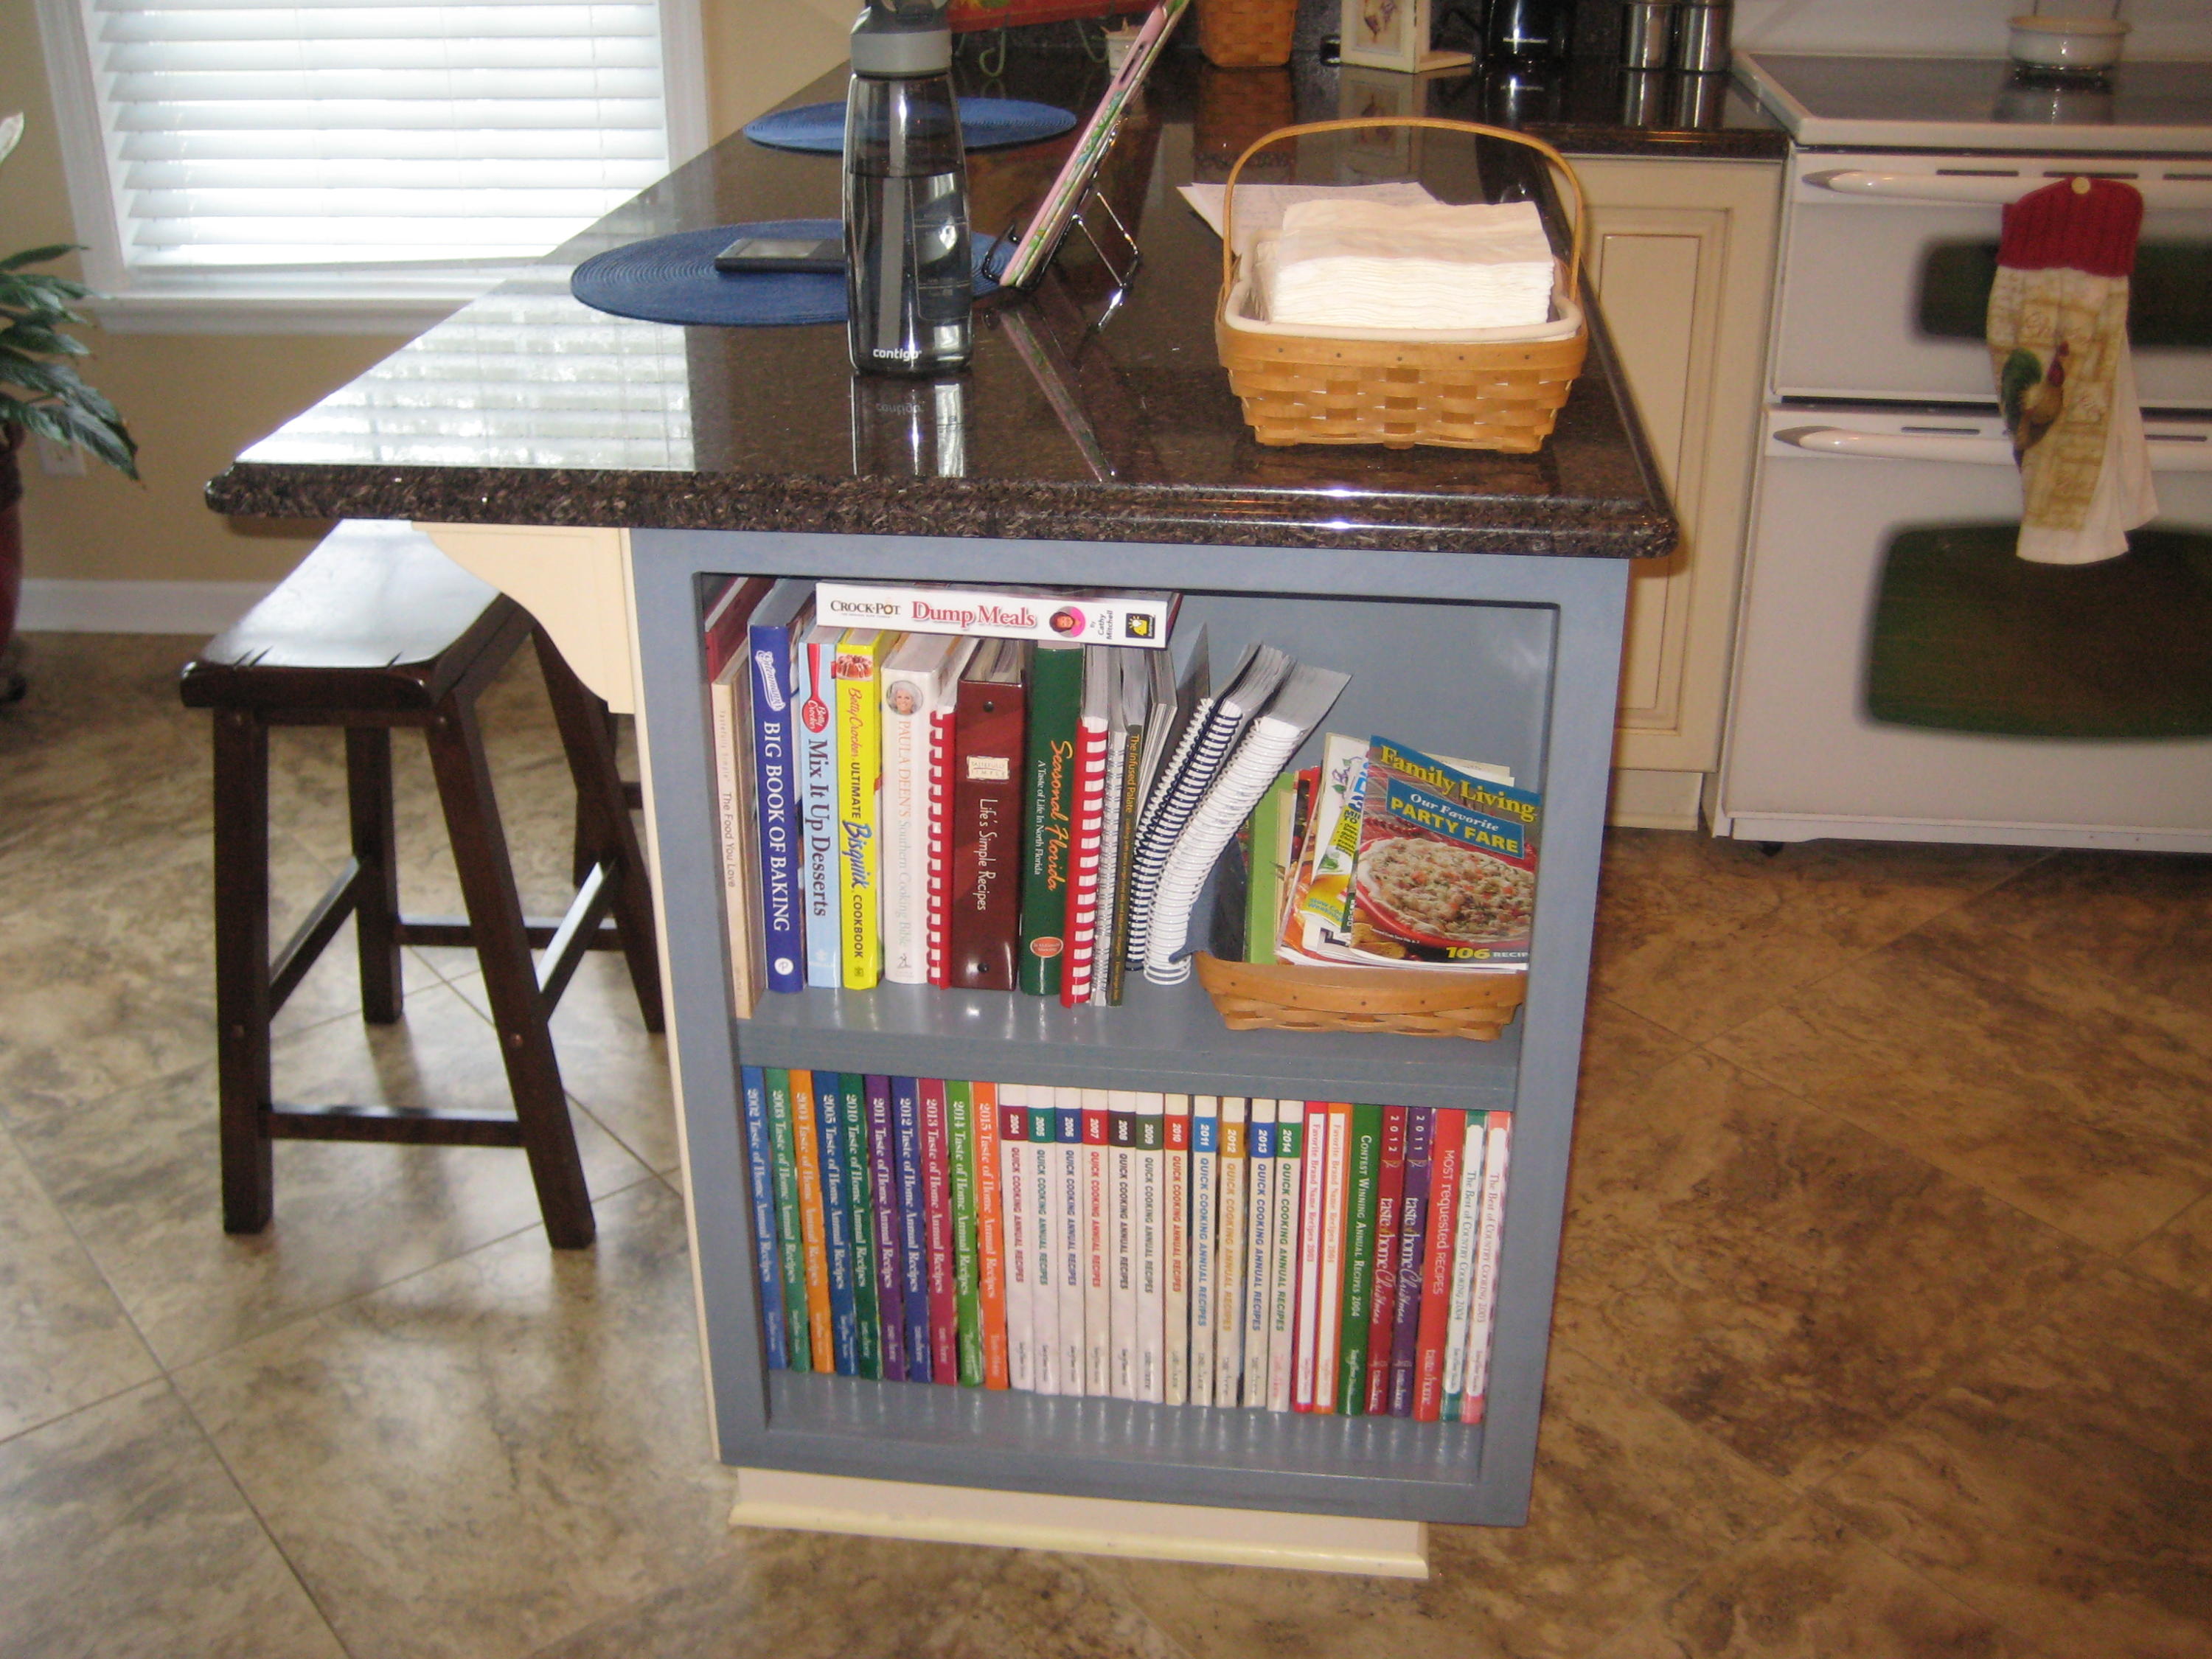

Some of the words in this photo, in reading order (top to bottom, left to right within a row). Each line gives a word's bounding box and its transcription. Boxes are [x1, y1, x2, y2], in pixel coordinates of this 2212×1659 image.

[872, 348, 922, 361] contigo
[912, 601, 974, 628] Dump
[977, 605, 1036, 627] Meals
[1098, 613, 1106, 636] Cathy
[808, 700, 818, 730] Crocker
[817, 706, 827, 727] Betty
[846, 687, 863, 713] Betty
[764, 721, 782, 758] BIG
[849, 714, 863, 757] Crocker
[898, 720, 911, 763] PAULA
[1129, 734, 1140, 752] The
[808, 740, 830, 778] Mix
[1127, 753, 1138, 785] Infused
[765, 764, 785, 824] BOOK
[810, 784, 830, 798] It
[850, 762, 860, 818] ULTIMATE
[898, 768, 911, 818] DEEN'S
[1037, 768, 1046, 788] Taste
[1037, 789, 1046, 799] of
[1050, 740, 1074, 821] Seasonal
[1380, 744, 1457, 796] Family
[1460, 779, 1537, 823] Living
[723, 792, 732, 810] The
[979, 799, 998, 827] Life's
[1036, 799, 1046, 814] Life
[1125, 786, 1136, 813] Palate
[1410, 793, 1439, 809] Our
[1439, 804, 1500, 832] Favorite
[724, 814, 734, 839] Food
[805, 804, 830, 831] Up
[1036, 815, 1045, 824] In
[1391, 796, 1459, 834] PARTY
[1464, 826, 1519, 853] FARE
[726, 841, 735, 860] You
[768, 829, 786, 853] OF
[973, 830, 998, 867] Simple
[1035, 824, 1045, 847] North
[842, 819, 872, 889] Bisquick
[1034, 848, 1044, 875] Florida
[1045, 824, 1069, 891] Florida
[726, 863, 736, 888] Love
[811, 835, 831, 917] Desserts
[973, 869, 996, 911] Recipes
[771, 856, 790, 932] BAKING
[853, 894, 863, 959] COOKBOOK
[1445, 946, 1491, 959] 106
[900, 1097, 913, 1126] 2012
[926, 1098, 939, 1127] 2013
[979, 1103, 992, 1131] 2015
[1009, 1114, 1020, 1135] 2004
[1035, 1116, 1046, 1137] 2005
[1064, 1116, 1074, 1138] 2006
[901, 1128, 914, 1158] Taste
[928, 1129, 939, 1159] Taste
[1090, 1118, 1099, 1139] 2007
[1119, 1120, 1128, 1141] 2008
[1144, 1124, 1154, 1144] 2009
[1172, 1122, 1182, 1143] 2010
[1200, 1124, 1210, 1146] 2011
[1226, 1129, 1237, 1153] 2012
[1258, 1129, 1268, 1153] 2013
[1282, 1129, 1292, 1153] 2014
[1311, 1124, 1321, 1157] Favorite
[955, 1131, 966, 1161] Taste
[981, 1133, 992, 1164] Taste
[1012, 1147, 1021, 1173] QUICK
[1037, 1150, 1046, 1175] QUICK
[1359, 1135, 1372, 1175] CONTEST
[1065, 1150, 1075, 1176] QUICK
[1091, 1151, 1100, 1178] QUICK
[1119, 1153, 1128, 1180] QUICK
[1144, 1157, 1153, 1183] QUICK
[1172, 1155, 1181, 1183] QUICK
[1200, 1158, 1209, 1191] QUICK
[1226, 1163, 1236, 1195] QUICK
[1257, 1164, 1266, 1195] QUICK
[1281, 1163, 1291, 1196] QUICK
[1310, 1160, 1319, 1185] Brand
[1442, 1150, 1455, 1180] MOST
[1466, 1171, 1477, 1188] The
[904, 1175, 916, 1208] Home
[930, 1175, 942, 1209] Home
[956, 1177, 968, 1211] Home
[982, 1180, 994, 1214] Home
[1012, 1175, 1022, 1213] COOKING
[1037, 1178, 1046, 1215] COOKING
[1066, 1178, 1076, 1216] COOKING
[1091, 1180, 1100, 1218] COOKING
[1119, 1182, 1128, 1220] COOKING
[1144, 1186, 1153, 1223] COOKING
[1172, 1184, 1181, 1222] COOKING
[1357, 1178, 1370, 1219] WINNING
[1464, 1190, 1475, 1208] Best
[1199, 1193, 1208, 1240] COOKING
[1225, 1198, 1234, 1245] COOKING
[1255, 1199, 1265, 1245] COOKING
[1279, 1198, 1290, 1245] COOKING
[1379, 1197, 1394, 1226] taste
[1404, 1197, 1419, 1226] taste
[1436, 1183, 1453, 1249] requested
[905, 1208, 919, 1249] Annual
[931, 1209, 945, 1251] Annual
[958, 1212, 970, 1252] Annual
[984, 1216, 996, 1255] Annual
[1014, 1215, 1023, 1248] ANNUAL
[1038, 1217, 1047, 1250] ANNUAL
[1067, 1217, 1076, 1251] ANNUAL
[1091, 1219, 1100, 1252] ANNUAL
[1119, 1221, 1128, 1254] ANNUAL
[1144, 1225, 1153, 1258] ANNUAL
[1172, 1224, 1181, 1257] ANNUAL
[1354, 1220, 1367, 1257] ANNUAL
[855, 1246, 867, 1287] Recipes
[1015, 1249, 1024, 1283] RECIPES
[1198, 1242, 1208, 1283] ANNUAL
[1377, 1234, 1396, 1269] home
[1402, 1234, 1421, 1268] home
[881, 1248, 894, 1289] Recipes
[907, 1251, 920, 1293] Recipes
[932, 1253, 945, 1294] Recipes
[959, 1254, 971, 1295] Recipes
[985, 1258, 997, 1298] Recipes
[1039, 1252, 1048, 1286] RECIPES
[1068, 1253, 1077, 1287] RECIPES
[1092, 1254, 1101, 1288] RECIPES
[1119, 1256, 1128, 1290] RECIPES
[1144, 1260, 1153, 1294] RECIPES
[1224, 1248, 1234, 1288] ANNUAL
[1253, 1248, 1263, 1288] ANNUAL
[1277, 1248, 1288, 1288] ANNUAL
[1352, 1259, 1364, 1293] RECIPES
[1433, 1251, 1446, 1295] RECIPES
[1197, 1286, 1207, 1327] RECIPES
[1222, 1291, 1232, 1332] RECIPES
[1252, 1290, 1262, 1332] RECIPES
[1276, 1290, 1286, 1332] RECIPES
[1373, 1269, 1396, 1324] Christmas
[1398, 1268, 1422, 1324] Christmas
